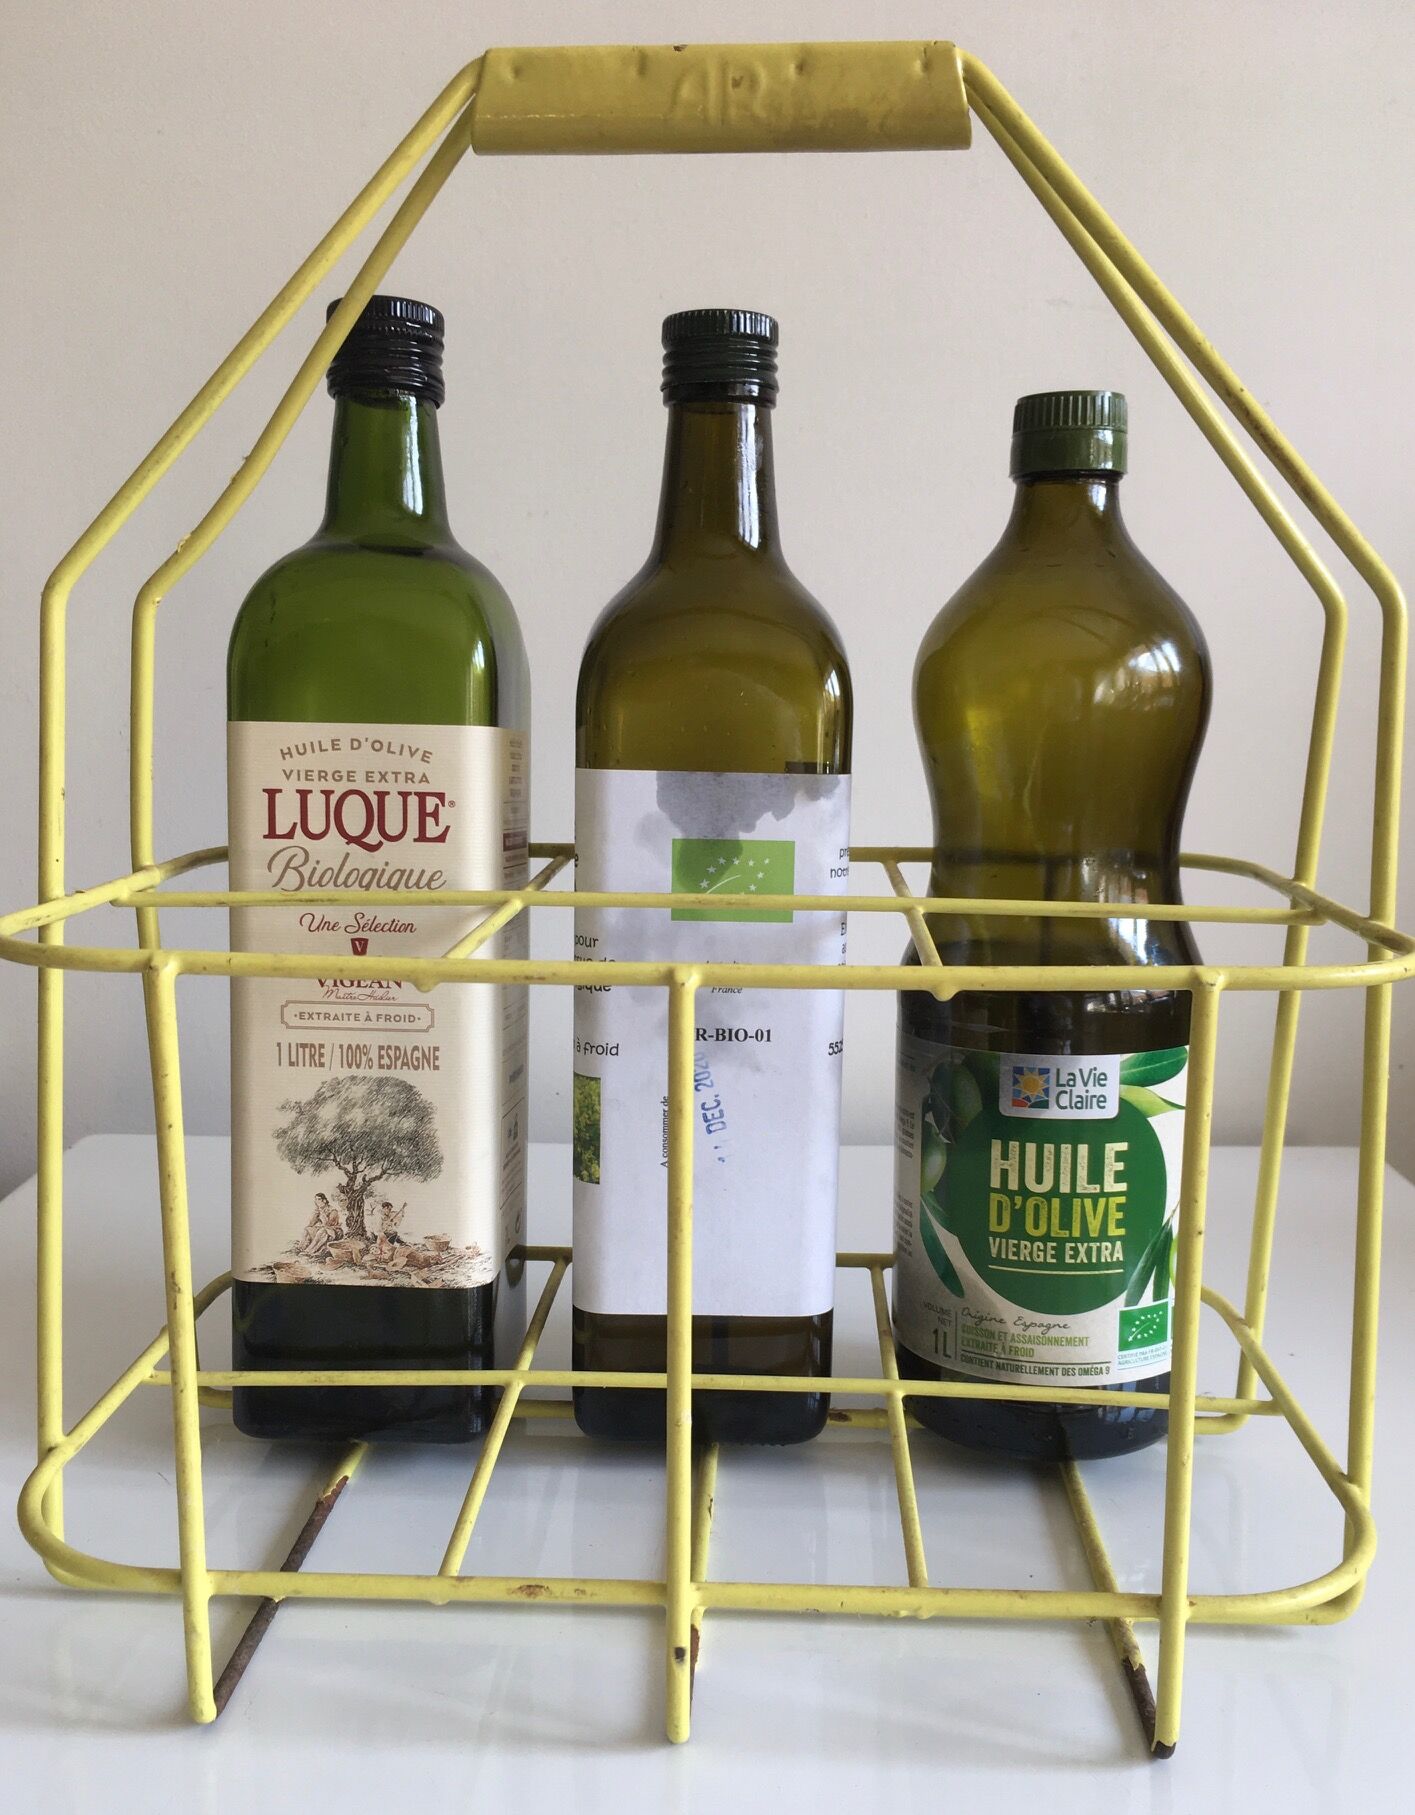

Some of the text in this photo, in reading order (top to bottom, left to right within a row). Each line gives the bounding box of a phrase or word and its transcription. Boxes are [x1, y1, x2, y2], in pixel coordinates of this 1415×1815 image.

[280, 737, 433, 764] HUILE D'OLIVE
[282, 769, 430, 784] VIERGE EXTRA
[267, 845, 447, 892] Biologique
[299, 911, 417, 934] Une Sélection
[298, 1011, 416, 1024] EXTRAITE À FROID
[695, 1028, 772, 1043] R-BIO-01
[276, 1042, 282, 1066] 1
[288, 1042, 326, 1068] LITRE
[338, 1043, 374, 1070] 100%
[378, 1045, 440, 1071] ESPAGNE
[584, 1042, 620, 1056] froid
[1055, 1067, 1108, 1088] La Vie
[660, 1096, 669, 1107] de
[1055, 1090, 1107, 1110] Claire
[661, 1108, 669, 1159] consommer
[990, 1139, 1128, 1193] HUILE
[989, 1193, 1126, 1238] D'OLIVE
[989, 1237, 1123, 1264] VIERGE EXTRA
[961, 1307, 1071, 1335] Origine Espagne
[961, 1323, 1089, 1347] CUISSON ET ASSAISONNEMENT
[961, 1337, 998, 1354] EXTRAITE
[1008, 1345, 1035, 1358] FROID
[960, 1353, 1111, 1377] CONTIENT NATURELLEMENT DES OMÉGA 9
